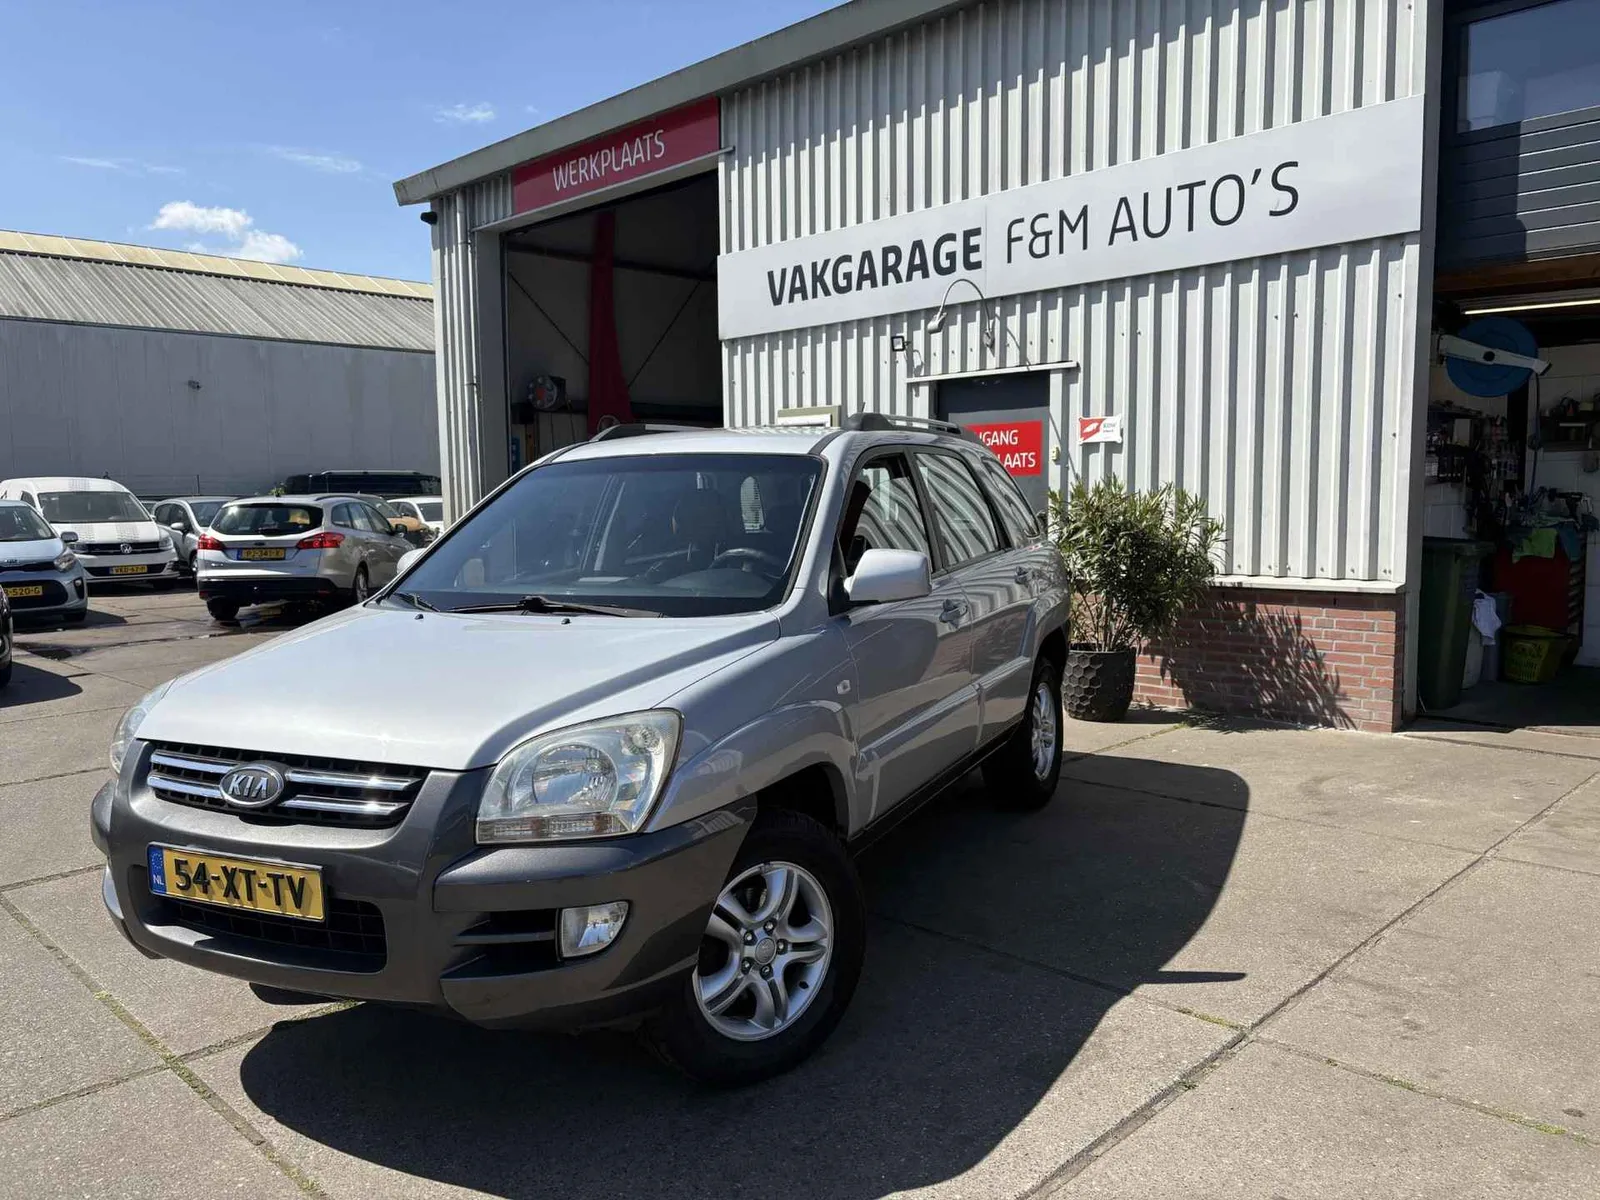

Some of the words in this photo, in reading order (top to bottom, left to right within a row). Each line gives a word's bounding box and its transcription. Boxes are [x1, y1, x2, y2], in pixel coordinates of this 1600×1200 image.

[553, 129, 665, 192] WERKPLAATS
[767, 226, 983, 307] VAKGARAGE
[1006, 204, 1089, 264] F&M
[1107, 161, 1299, 246] AUTO'S
[228, 774, 269, 799] KIA
[152, 875, 165, 886] NL
[174, 858, 306, 909] 54-XT-TV
